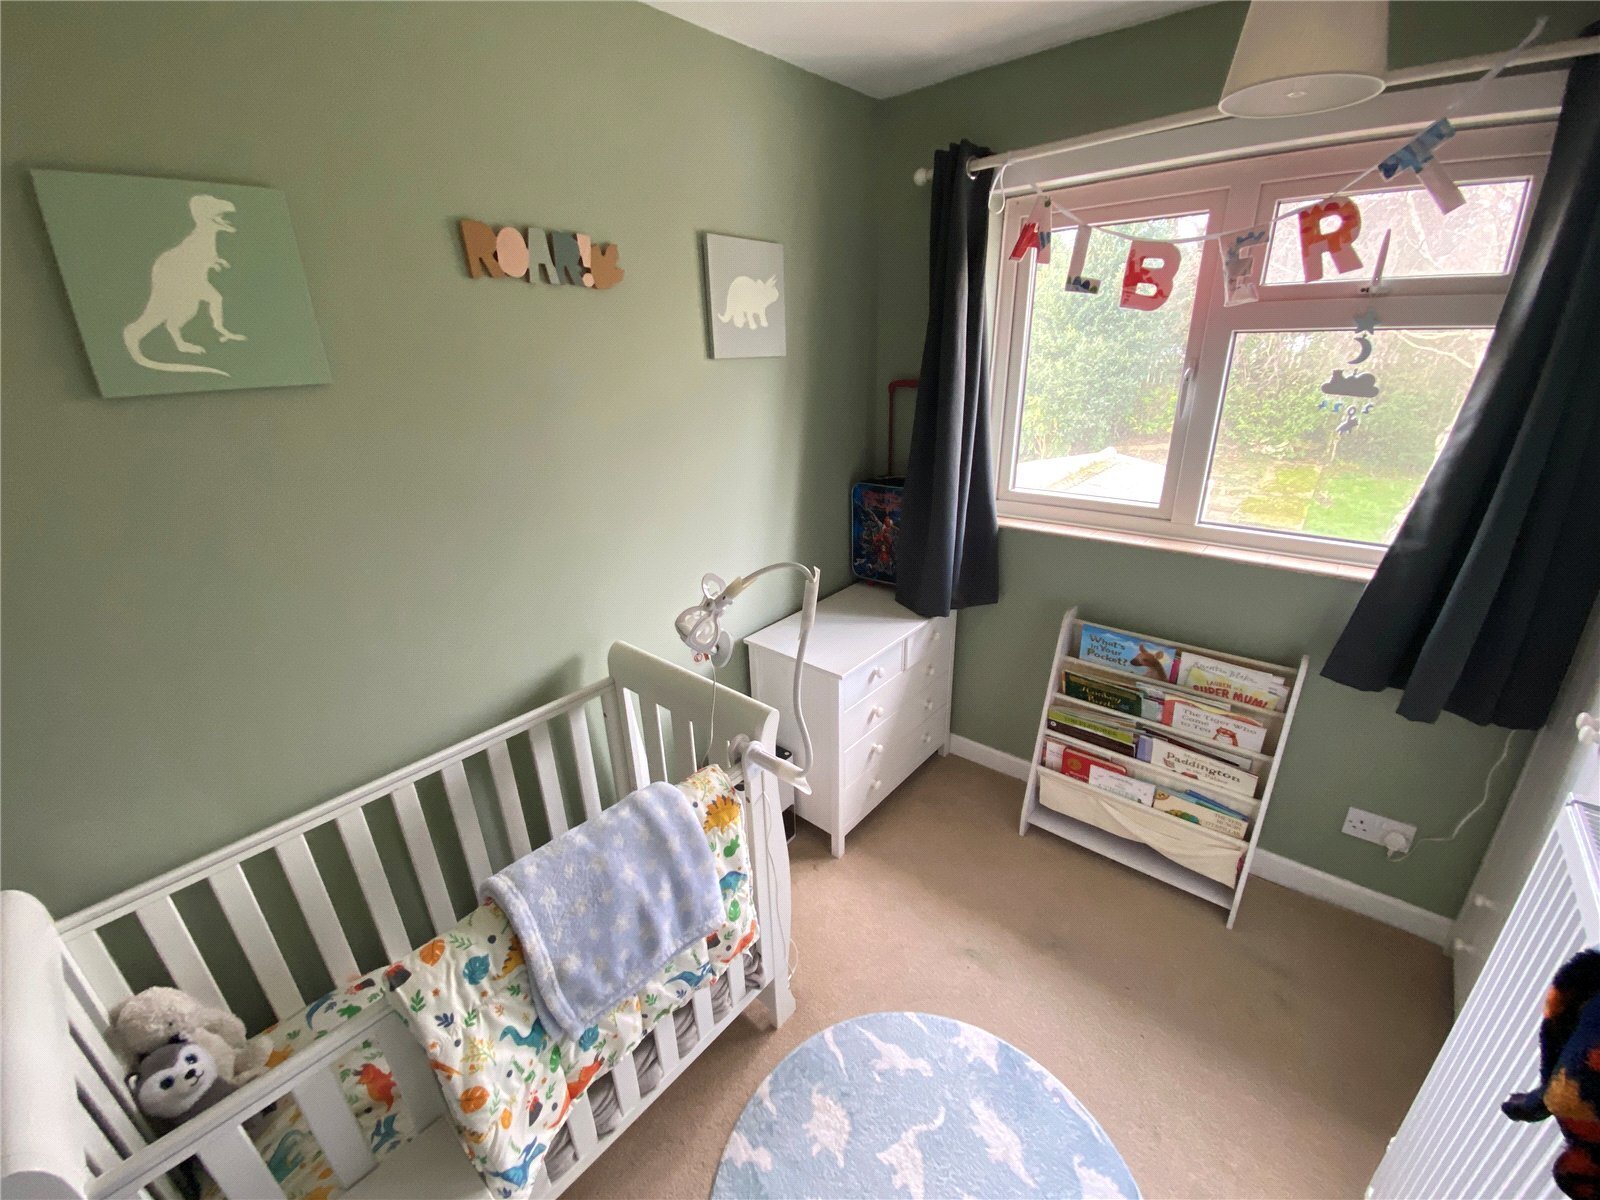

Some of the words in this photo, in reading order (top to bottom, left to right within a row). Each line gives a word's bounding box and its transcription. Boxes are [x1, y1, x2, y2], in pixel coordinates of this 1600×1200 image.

[460, 219, 595, 288] ROAR!
[1089, 634, 1125, 650] What's
[1087, 648, 1128, 666] Pocket?
[1100, 645, 1122, 656] Your
[1233, 692, 1268, 708] MUM!
[1182, 715, 1210, 726] Came
[1184, 709, 1200, 717] The
[1204, 713, 1229, 726] Tiger
[1192, 723, 1211, 733] Tea
[1167, 752, 1241, 783] Paddington
